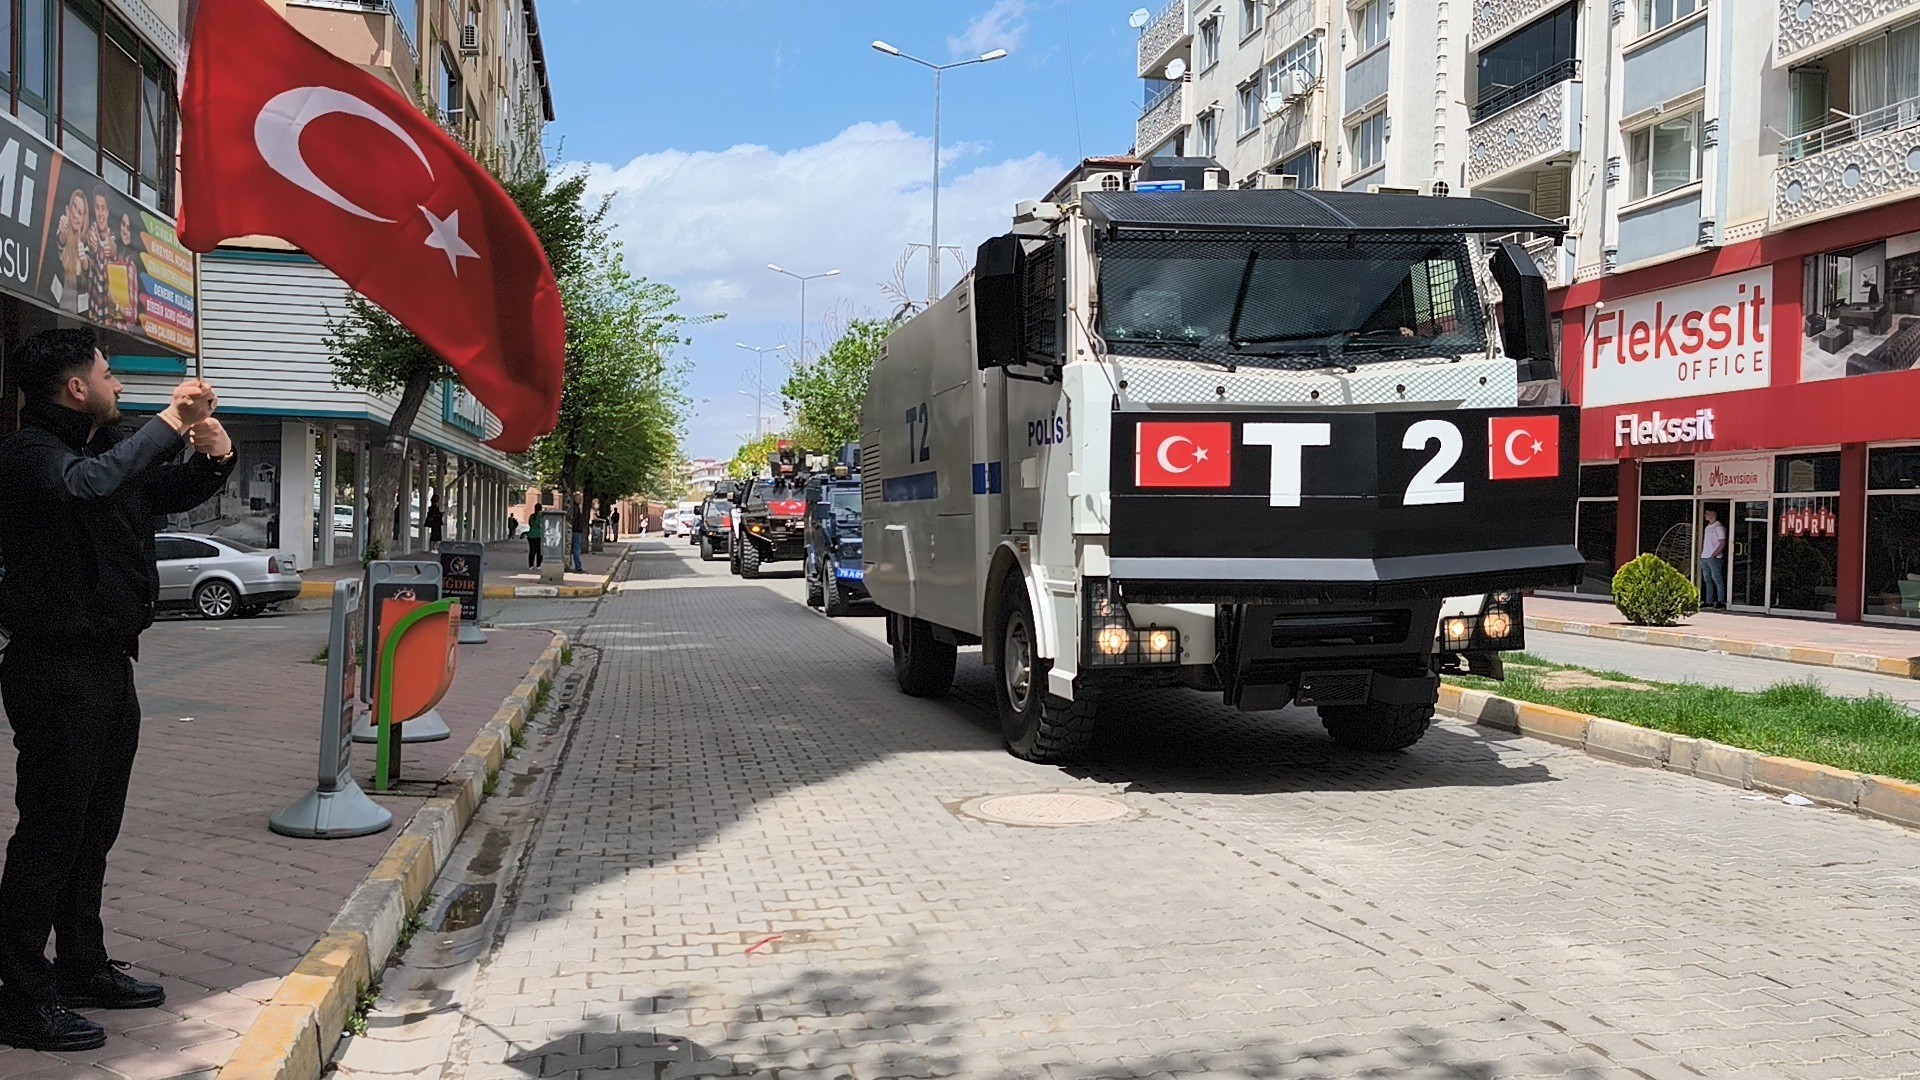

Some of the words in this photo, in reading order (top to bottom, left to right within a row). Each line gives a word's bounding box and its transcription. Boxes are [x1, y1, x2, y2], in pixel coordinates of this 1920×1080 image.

[0, 238, 29, 283] SU
[1592, 284, 1766, 369] Flekssit
[1678, 351, 1763, 381] OFFICE
[906, 402, 930, 464] T2
[1028, 410, 1064, 447] POLİS
[1615, 408, 1715, 447] Flekssit
[1242, 422, 1331, 507] T
[1402, 419, 1464, 506] 2
